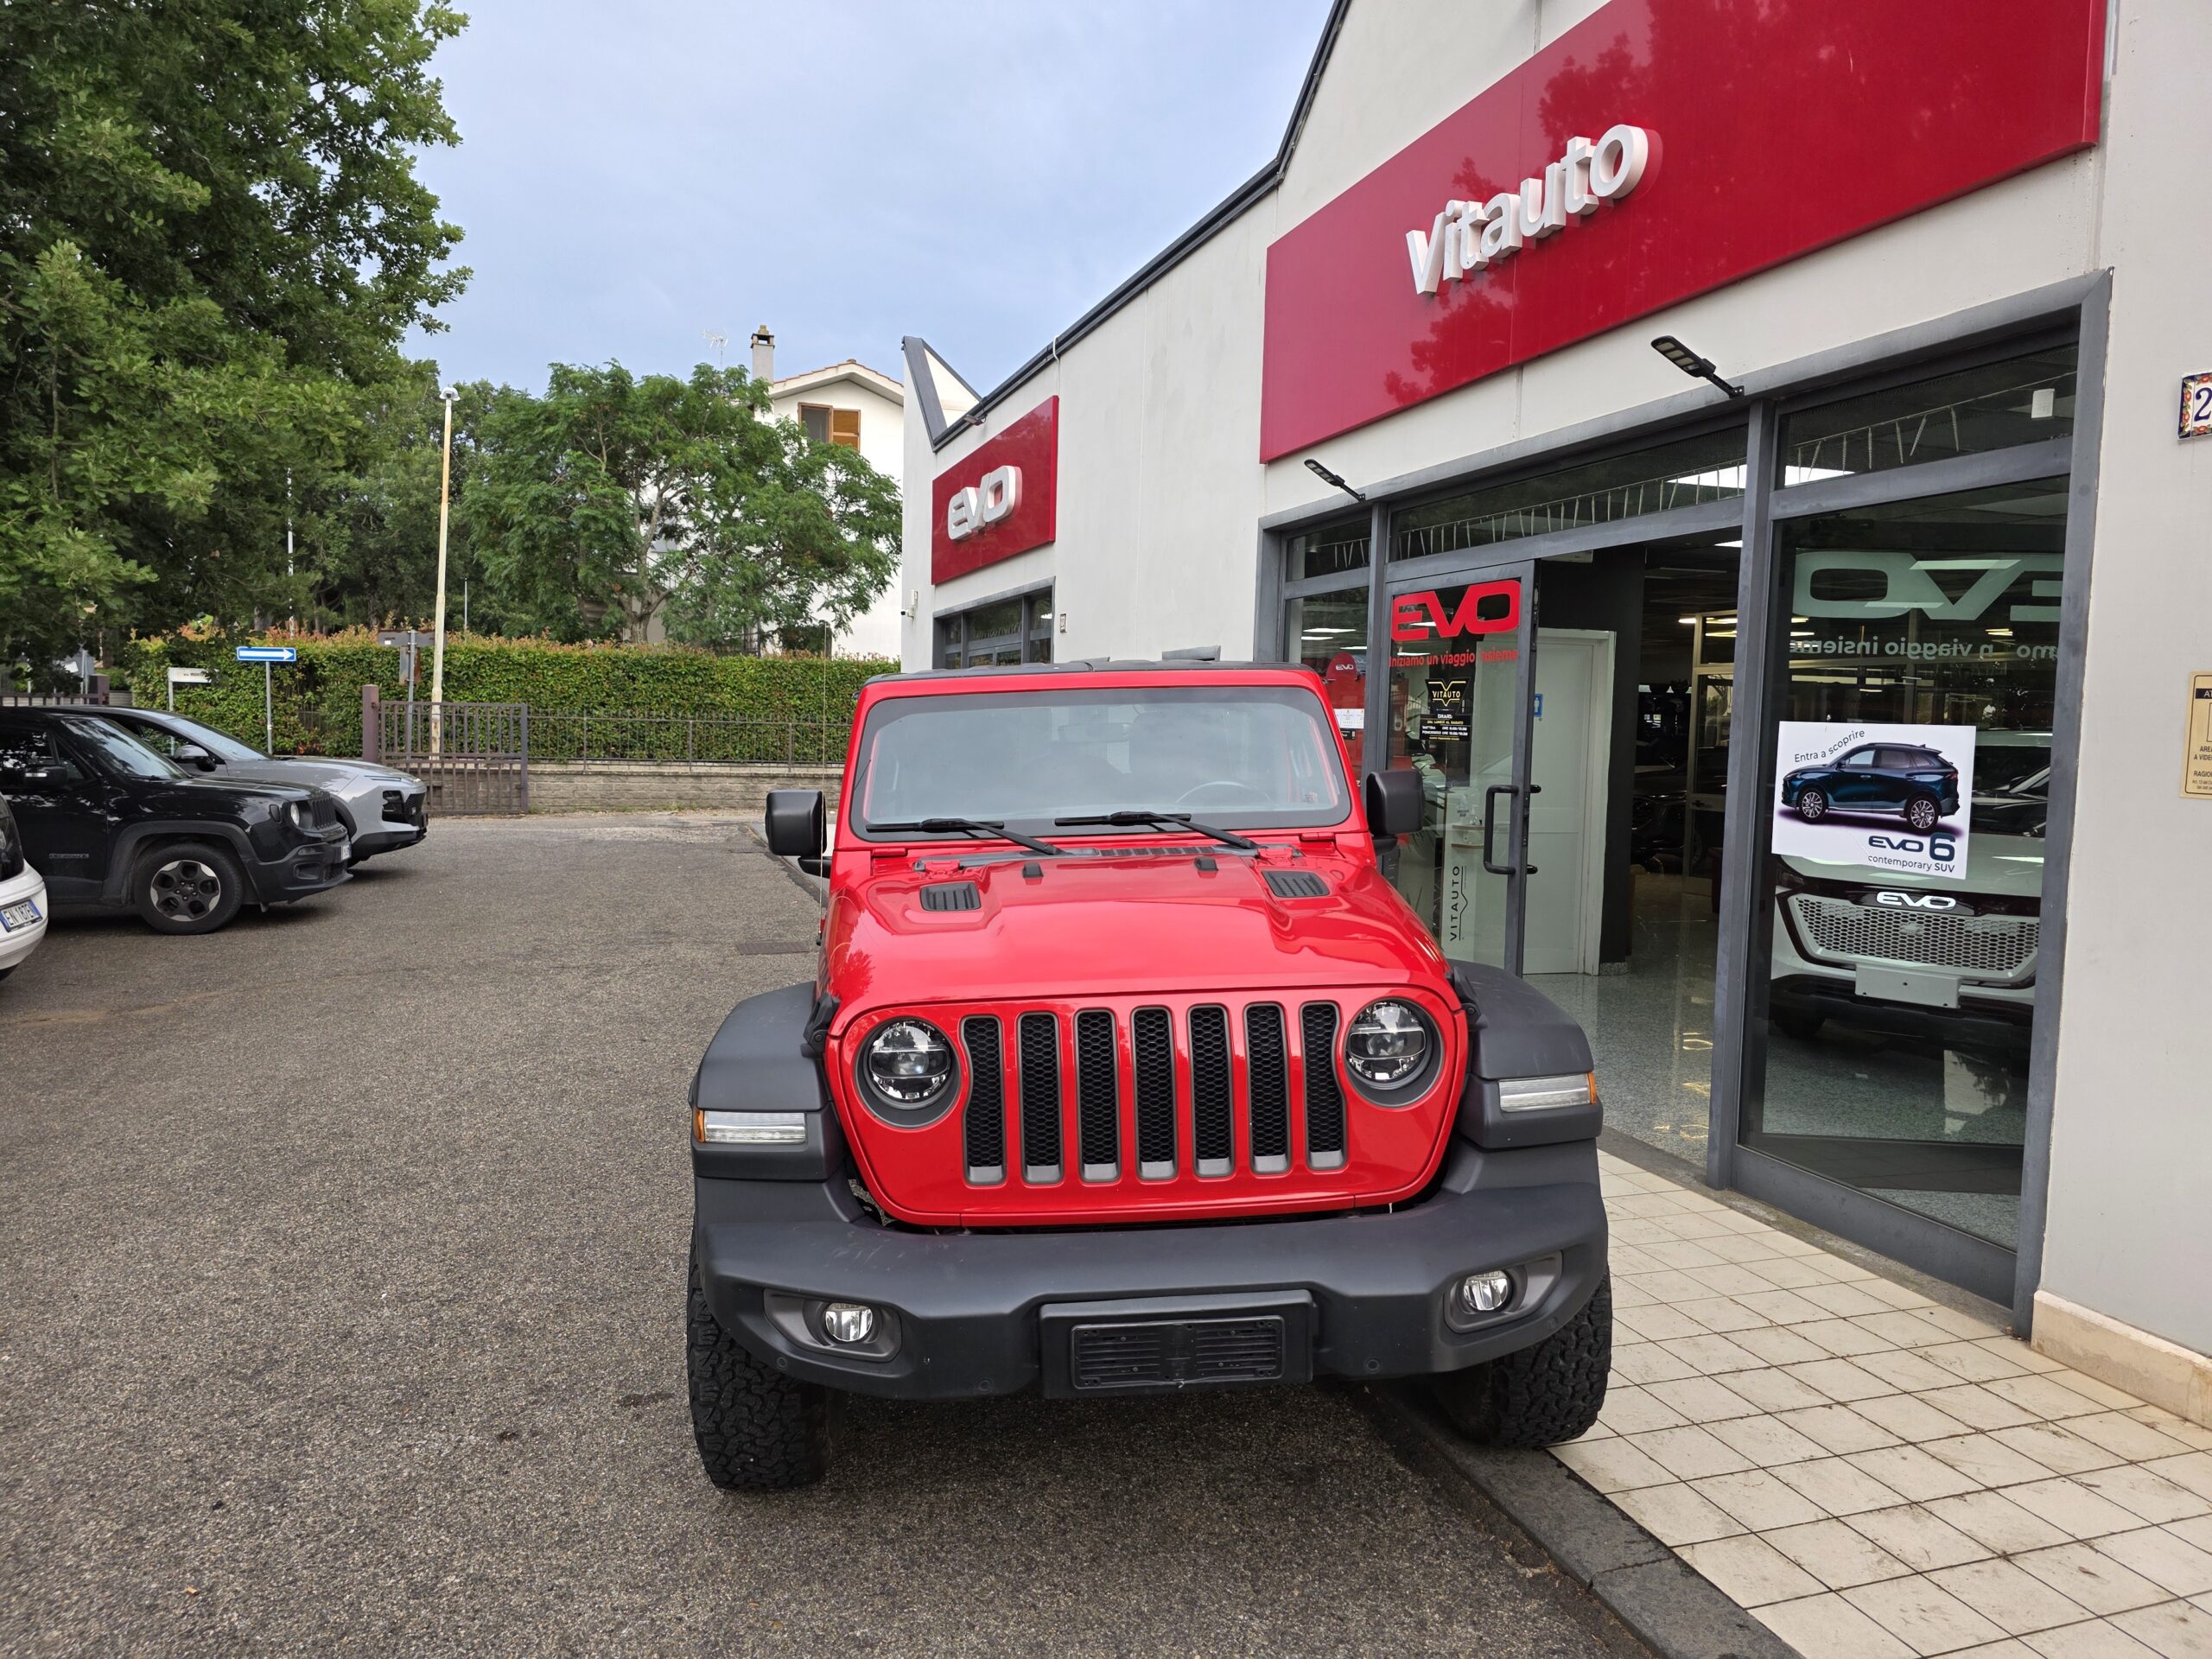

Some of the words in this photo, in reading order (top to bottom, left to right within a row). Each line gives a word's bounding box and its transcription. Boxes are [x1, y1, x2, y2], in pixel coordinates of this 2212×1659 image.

[1406, 124, 1649, 295] Vitauto
[948, 465, 1017, 540] EVO
[1391, 580, 1521, 641] EVO
[1389, 656, 1425, 667] Iniziamo
[1427, 655, 1439, 665] un
[1440, 649, 1475, 667] viaggio
[1795, 752, 1819, 763] Entra
[1821, 750, 1827, 759] a
[1828, 729, 1866, 755] scoprire
[1868, 836, 1923, 853] EVO
[1929, 831, 1955, 862] 6
[1868, 855, 1932, 872] contemporary
[1934, 862, 1955, 873] SUV
[1450, 866, 1459, 942] VITAUTO
[1876, 891, 1957, 911] EVO
